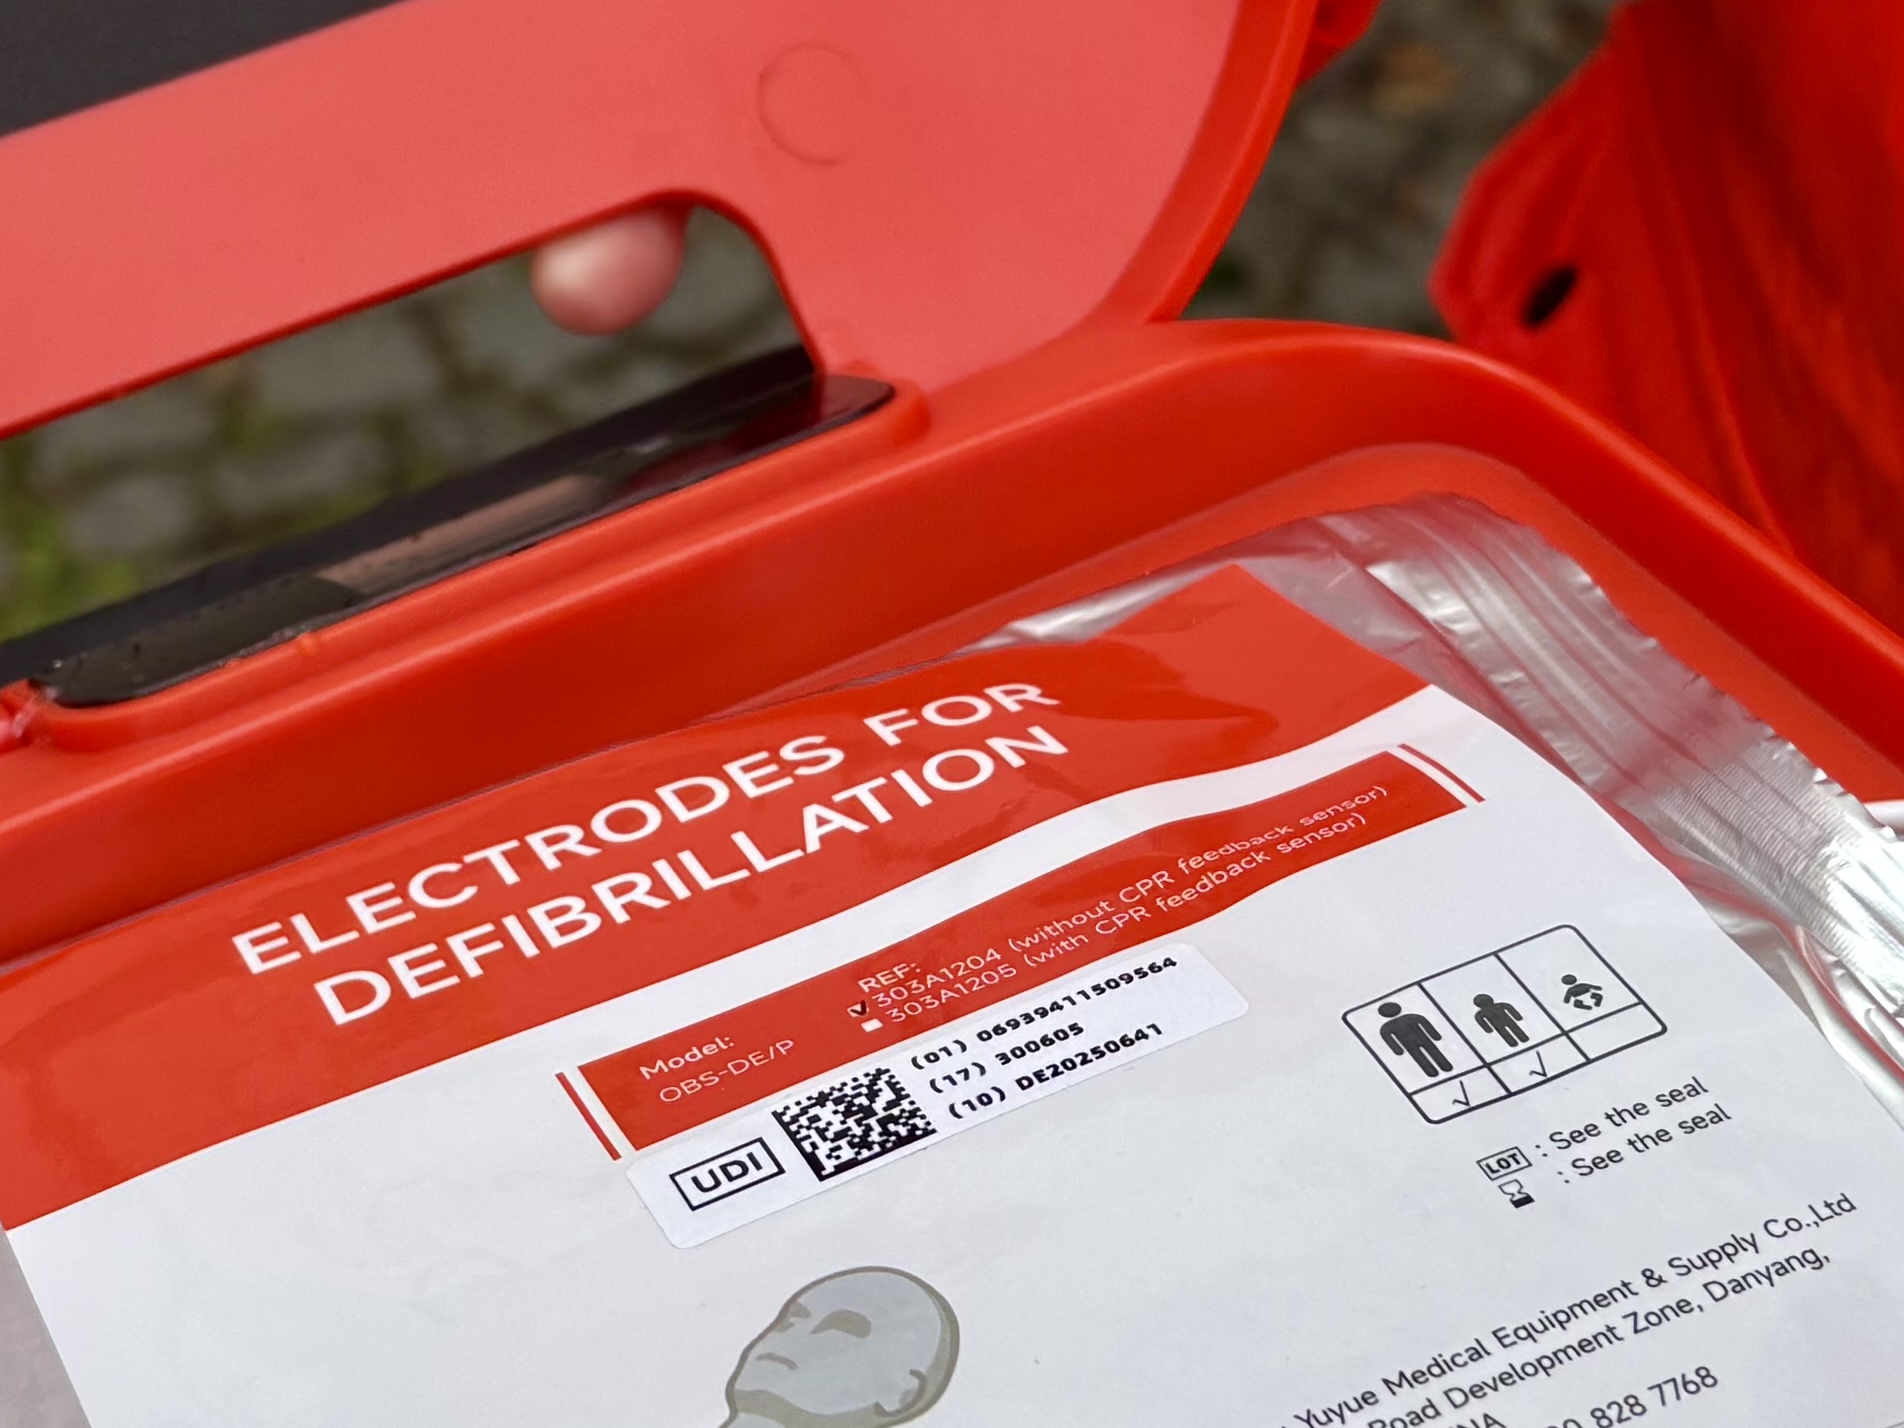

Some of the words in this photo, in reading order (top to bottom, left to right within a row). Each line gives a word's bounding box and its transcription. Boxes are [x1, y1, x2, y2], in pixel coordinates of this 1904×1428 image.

[232, 733, 846, 976] ELECTRODES
[864, 681, 1060, 747] FOR
[313, 725, 1070, 1026] DEFIBRILLATION
[872, 947, 1002, 1008] 303A1204
[1008, 900, 1115, 952] (without
[1119, 871, 1175, 903] CPR
[1177, 823, 1294, 875] feedback
[1299, 785, 1388, 826] sensor)
[887, 963, 1017, 1023] 303A1205
[1024, 935, 1089, 968] (with
[1095, 906, 1152, 935] CPR
[1156, 848, 1272, 912] feedback
[1276, 812, 1367, 854] sensor)
[858, 961, 921, 993] REF:
[911, 1039, 968, 1070] (01)
[976, 956, 1178, 1042] 06939411509564
[639, 1033, 735, 1081] Model:
[659, 1038, 795, 1104] OBS-DE/P
[930, 1062, 987, 1094] (17)
[995, 1022, 1085, 1066] 300605
[949, 1086, 1006, 1120] (10)
[1015, 1023, 1163, 1092] DE20250641
[691, 1151, 763, 1193] UDI
[1484, 1151, 1523, 1175] LOT
[1549, 1122, 1601, 1151] See
[1604, 1098, 1651, 1129] the
[1655, 1076, 1710, 1108] seal
[1571, 1148, 1624, 1178] See
[1627, 1125, 1674, 1156] the
[1678, 1103, 1732, 1135] seal
[1381, 1338, 1492, 1397] Medical
[1492, 1279, 1640, 1350] Equipment
[1640, 1268, 1667, 1290] &
[1668, 1232, 1761, 1278] Supply
[1763, 1192, 1858, 1240] Co.,Ltd
[1443, 1324, 1625, 1409] Development
[1622, 1297, 1704, 1336] Zone,
[1702, 1246, 1831, 1304] Danyang,
[1648, 1365, 1719, 1409] 7768
